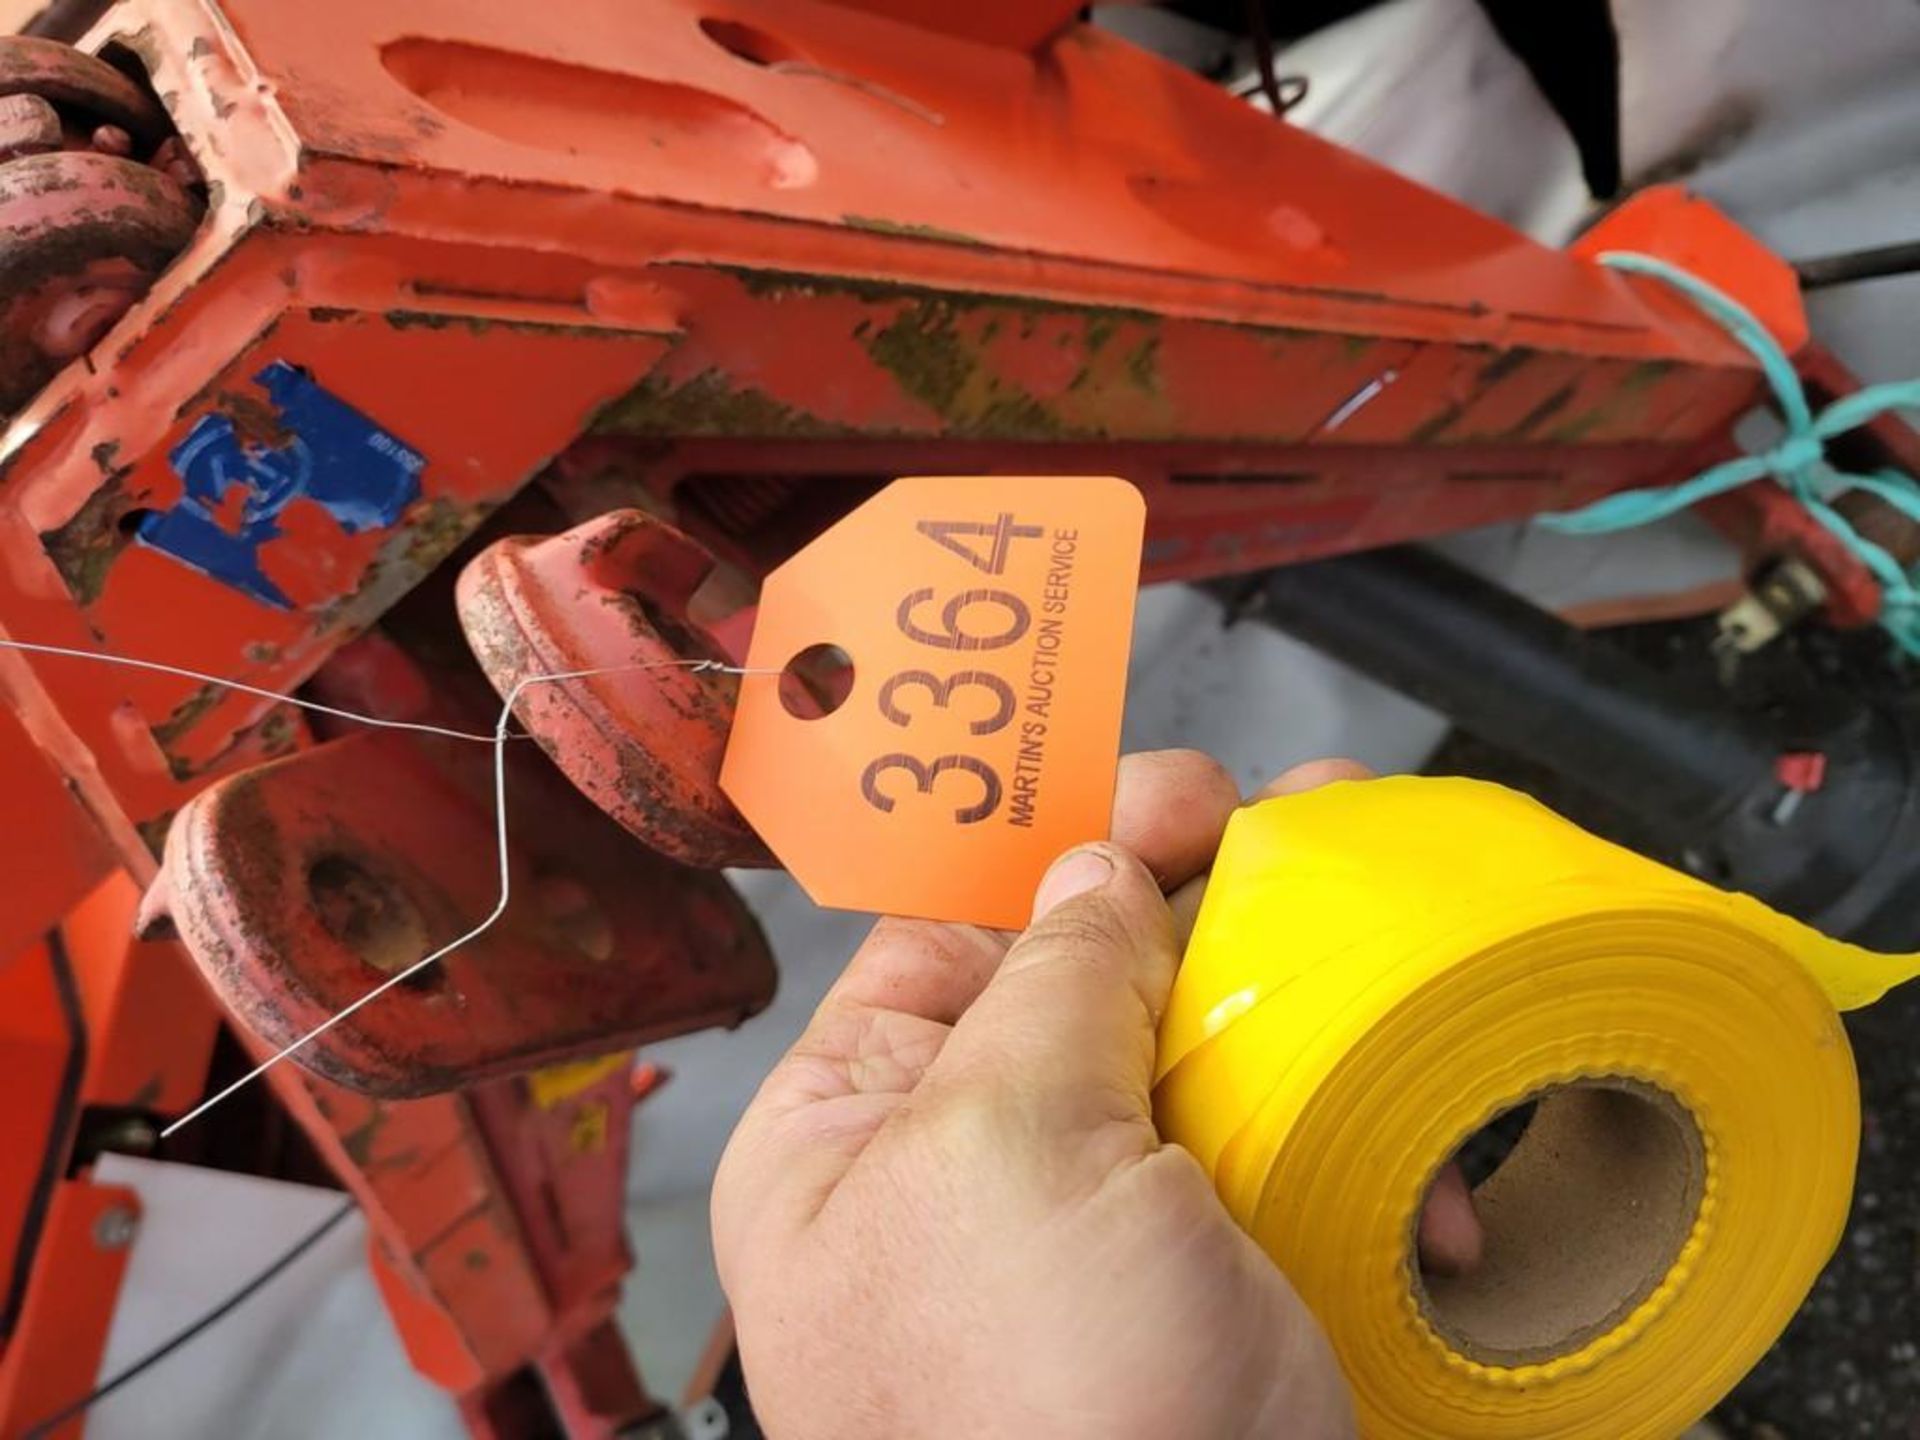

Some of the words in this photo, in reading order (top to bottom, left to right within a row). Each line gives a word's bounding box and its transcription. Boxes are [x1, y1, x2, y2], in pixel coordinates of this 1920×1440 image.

[1043, 528, 1079, 615] SERVICE
[860, 512, 1044, 825] 3364
[1026, 619, 1064, 719] AUCTION
[1008, 720, 1046, 828] MARTIN'S
